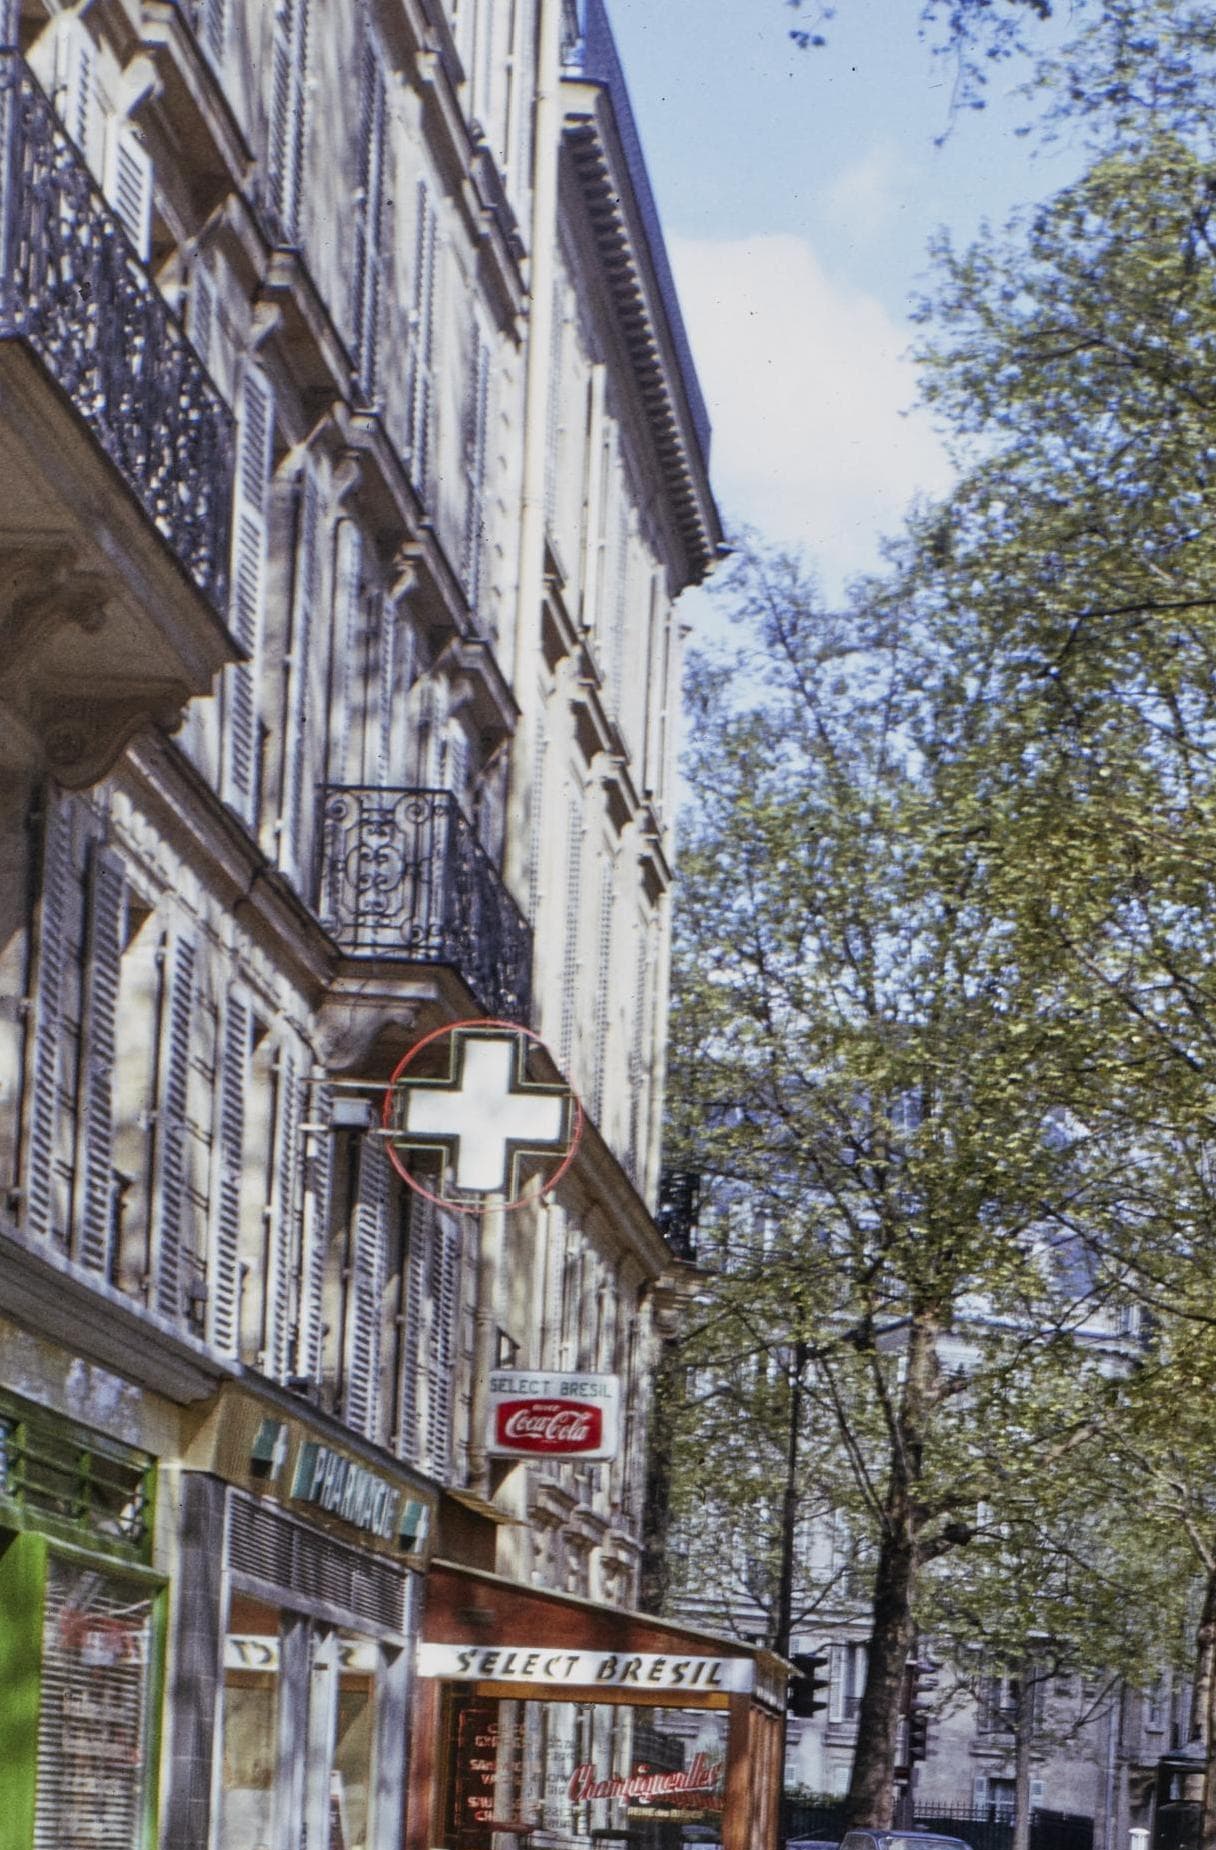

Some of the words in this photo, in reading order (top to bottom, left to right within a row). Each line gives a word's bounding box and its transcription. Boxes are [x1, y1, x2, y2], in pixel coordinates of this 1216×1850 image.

[490, 1377, 550, 1395] SELECT
[560, 1381, 613, 1399] BRESIL
[308, 1447, 400, 1539] PHARMACIE
[457, 1649, 580, 1678] SELECT
